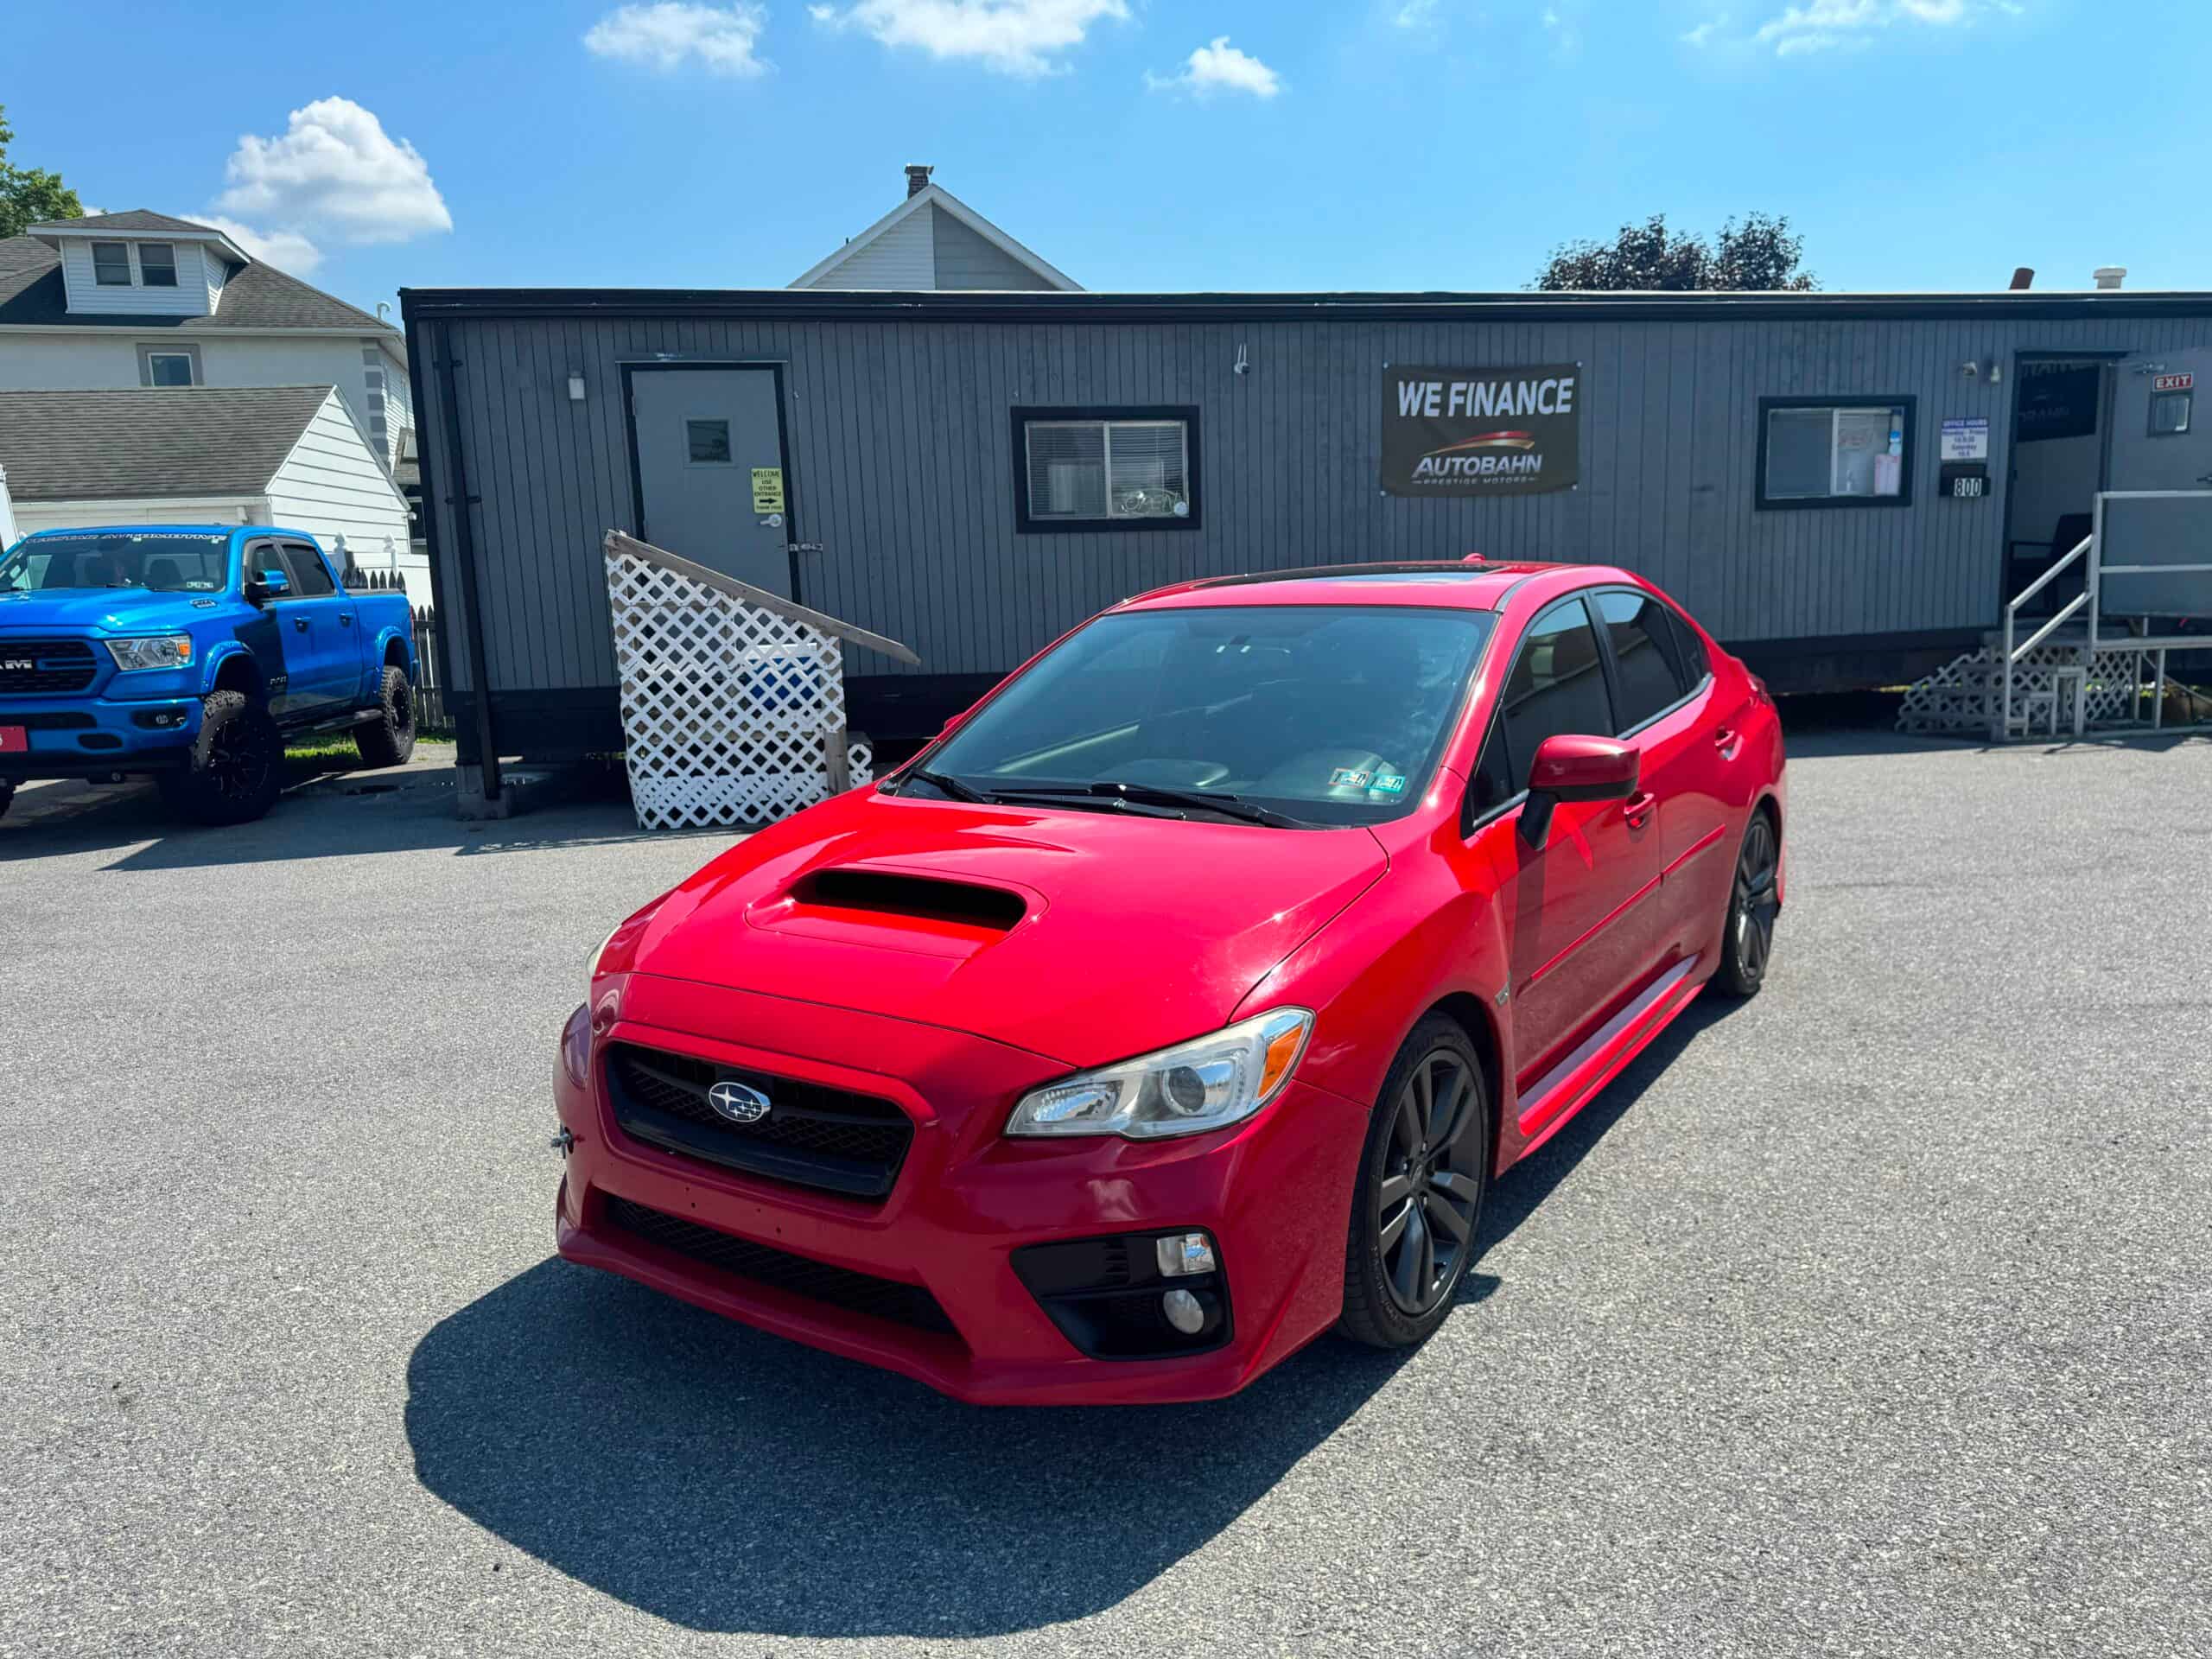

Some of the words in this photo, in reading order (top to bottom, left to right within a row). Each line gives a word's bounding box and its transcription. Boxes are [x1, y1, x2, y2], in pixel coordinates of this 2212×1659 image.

[2156, 375, 2190, 388] EXIT
[1397, 380, 1444, 417] WE
[1447, 377, 1575, 417] FINANCE
[1411, 454, 1543, 479] AUTOBAHN
[1955, 478, 1981, 497] 800
